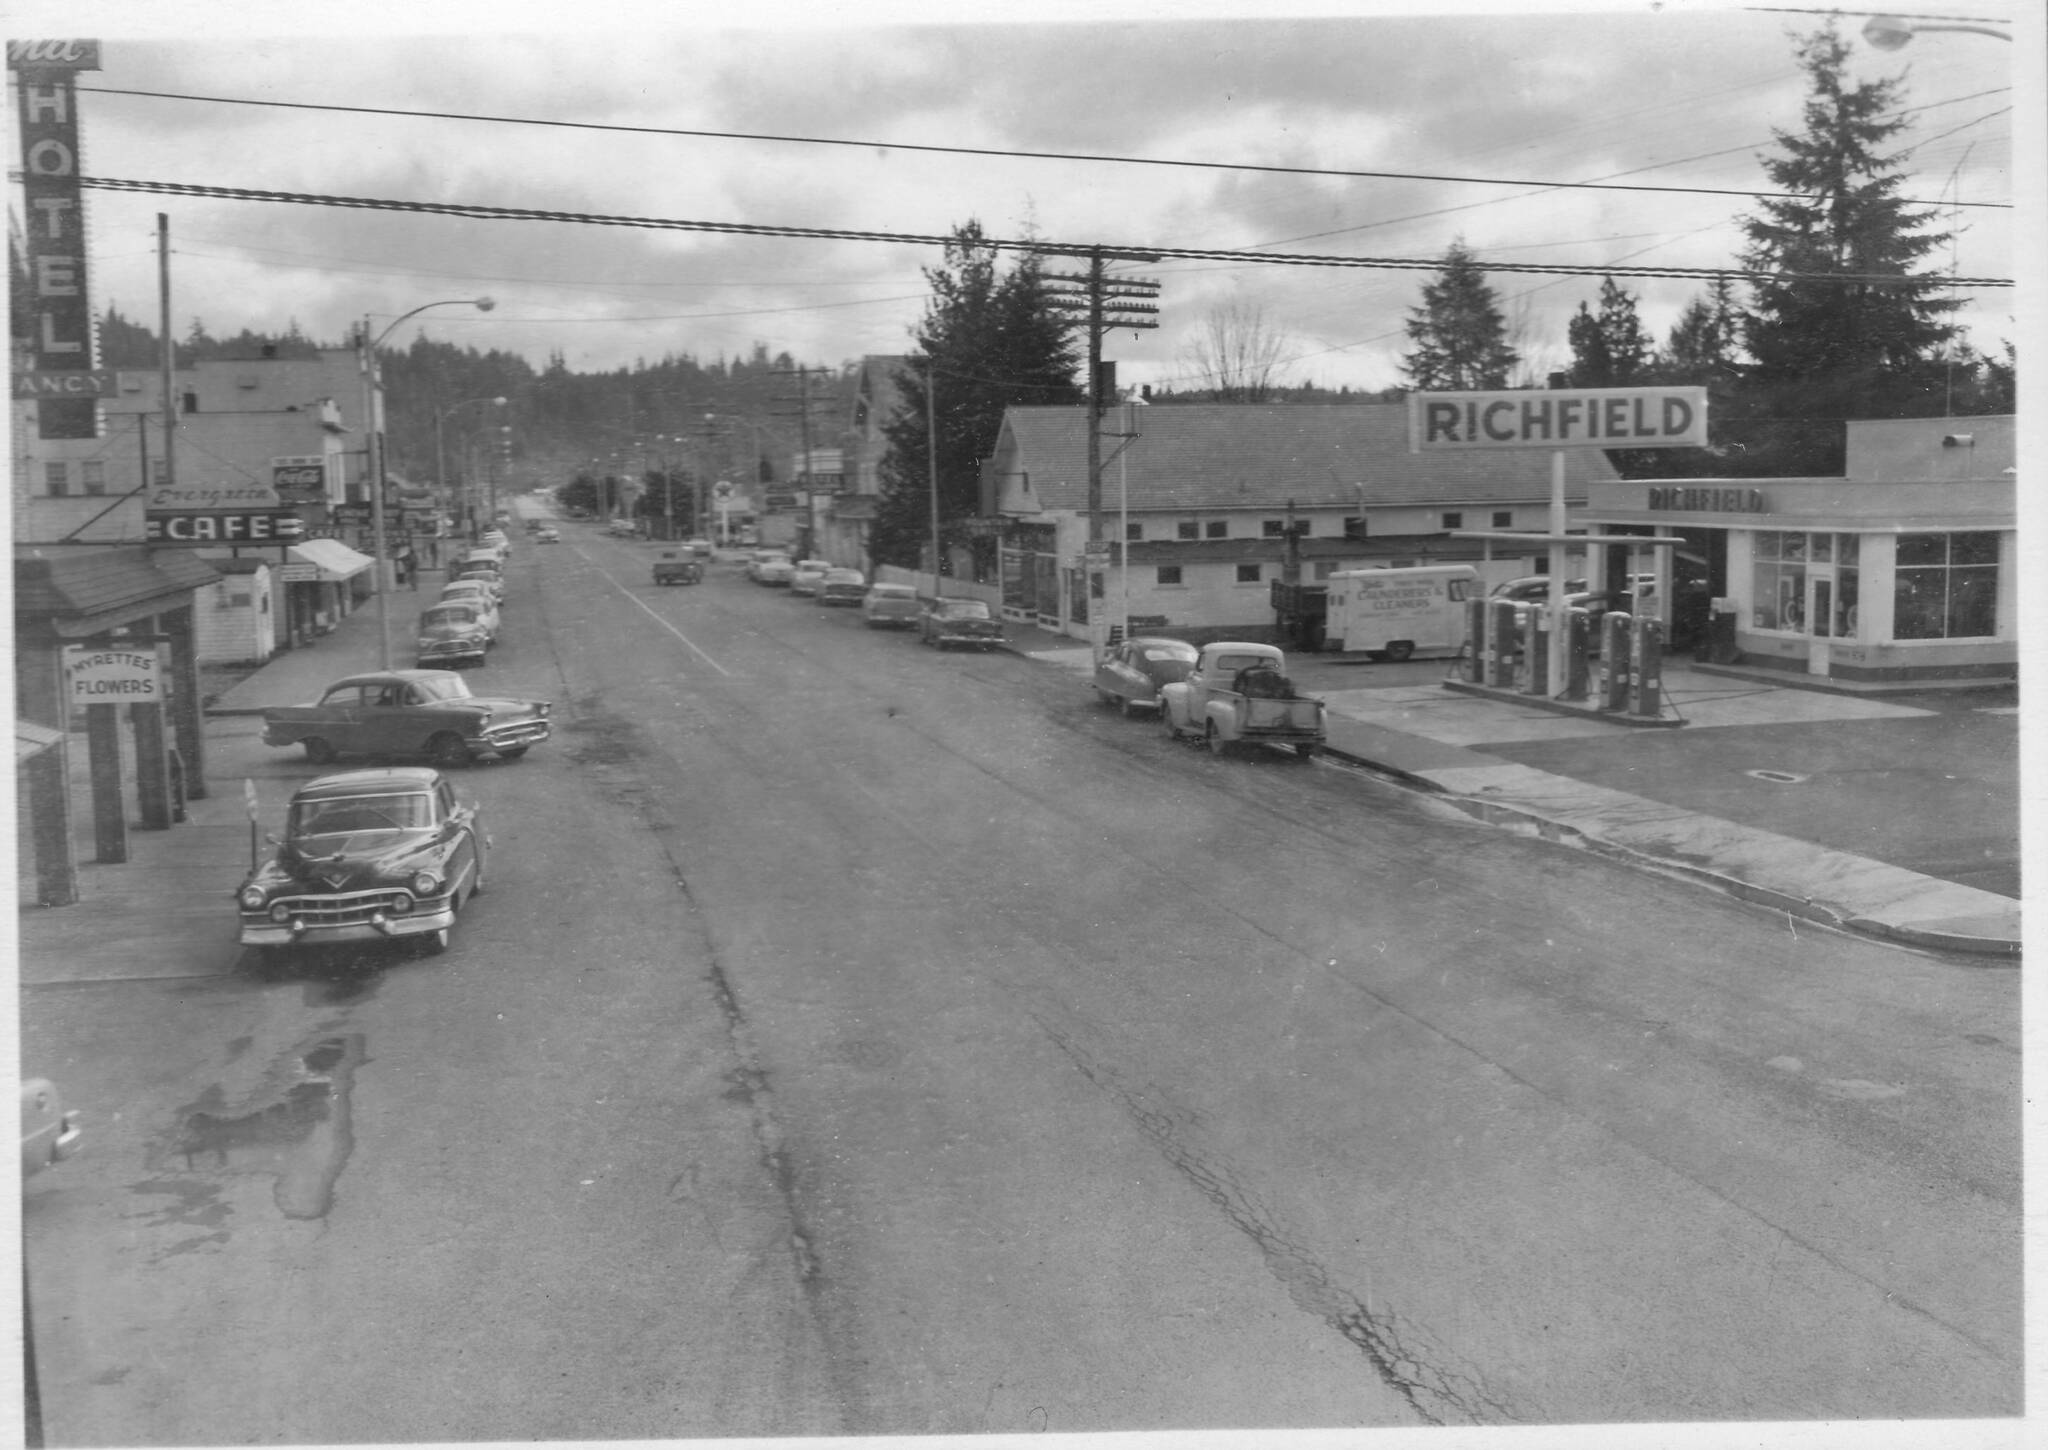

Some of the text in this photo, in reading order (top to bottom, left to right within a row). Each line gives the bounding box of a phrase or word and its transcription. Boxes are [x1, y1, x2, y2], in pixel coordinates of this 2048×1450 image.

[28, 84, 81, 353] HOTEL
[1426, 397, 1693, 442] RICHFIELD
[1648, 487, 1764, 513] RICHFIELD
[166, 516, 270, 540] CAFE
[1374, 599, 1430, 610] CLEANERS
[76, 679, 154, 694] FLOWERS
